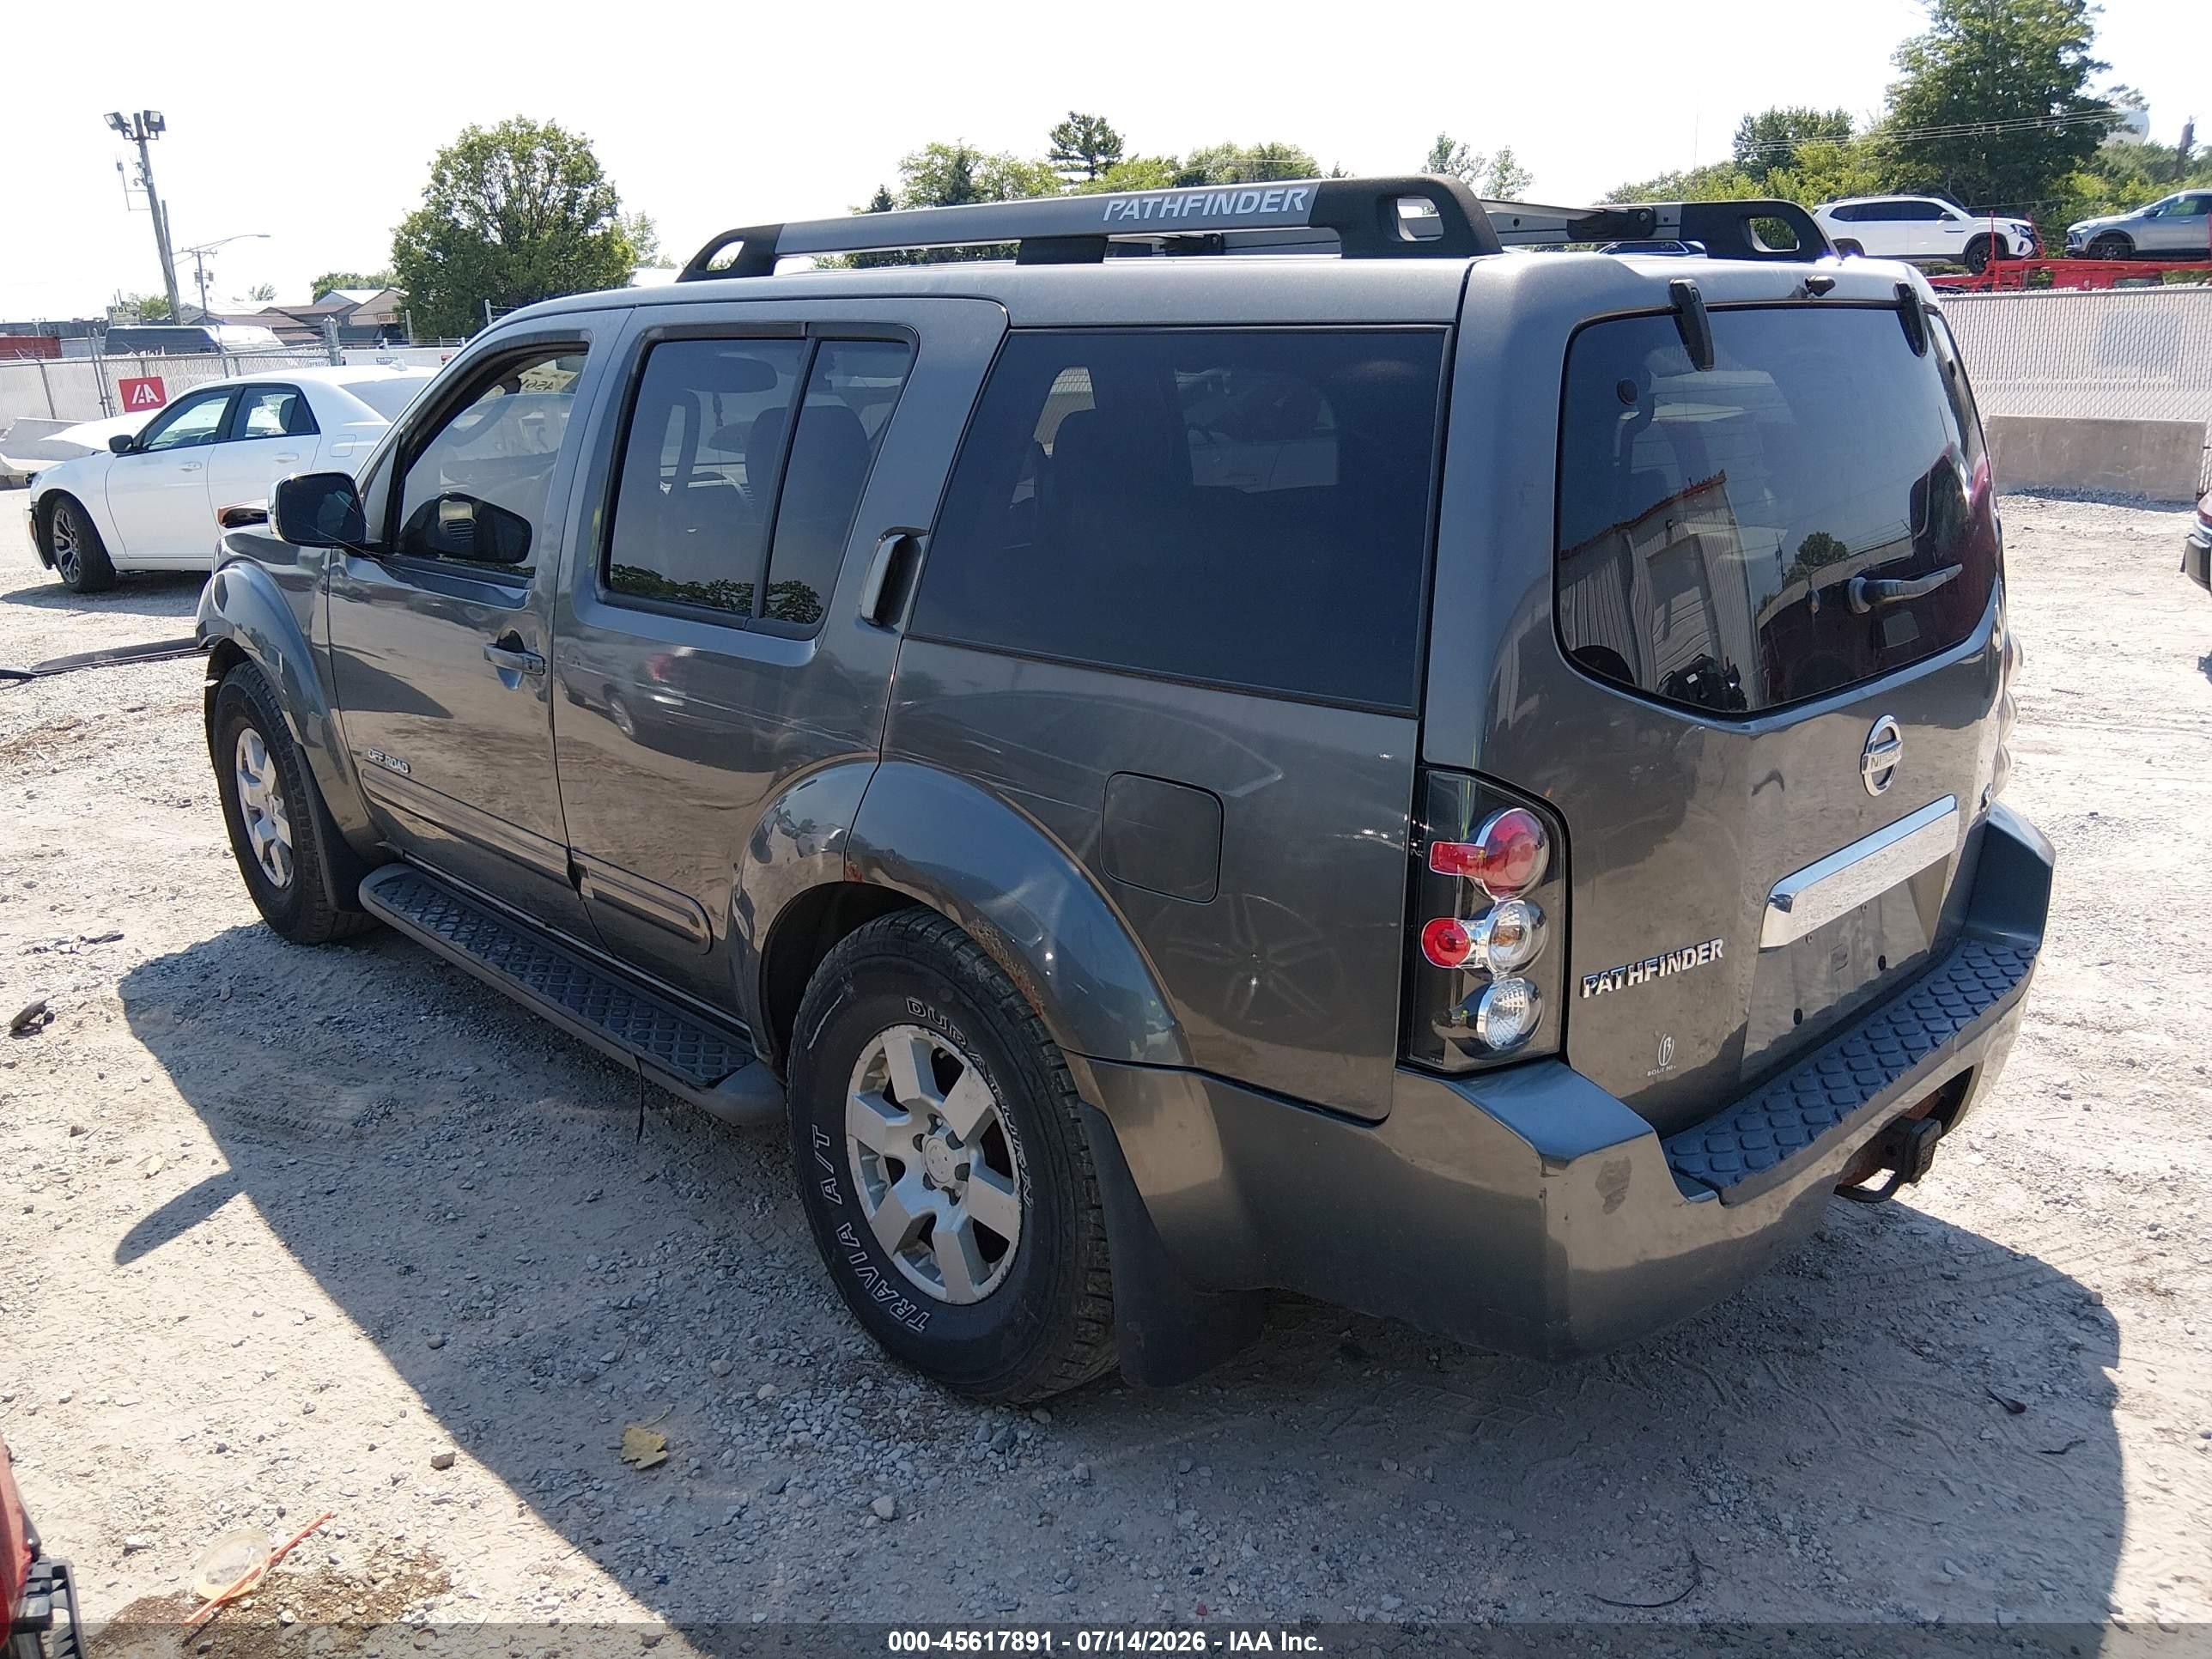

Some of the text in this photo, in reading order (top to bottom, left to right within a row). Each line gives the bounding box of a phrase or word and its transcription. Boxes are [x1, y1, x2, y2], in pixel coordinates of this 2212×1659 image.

[1103, 188, 1310, 222] PATHFINDER
[385, 754, 410, 775] ROAD
[1580, 938, 1724, 1000] PATHFINDER
[811, 1124, 933, 1334] TRAVIA A/T
